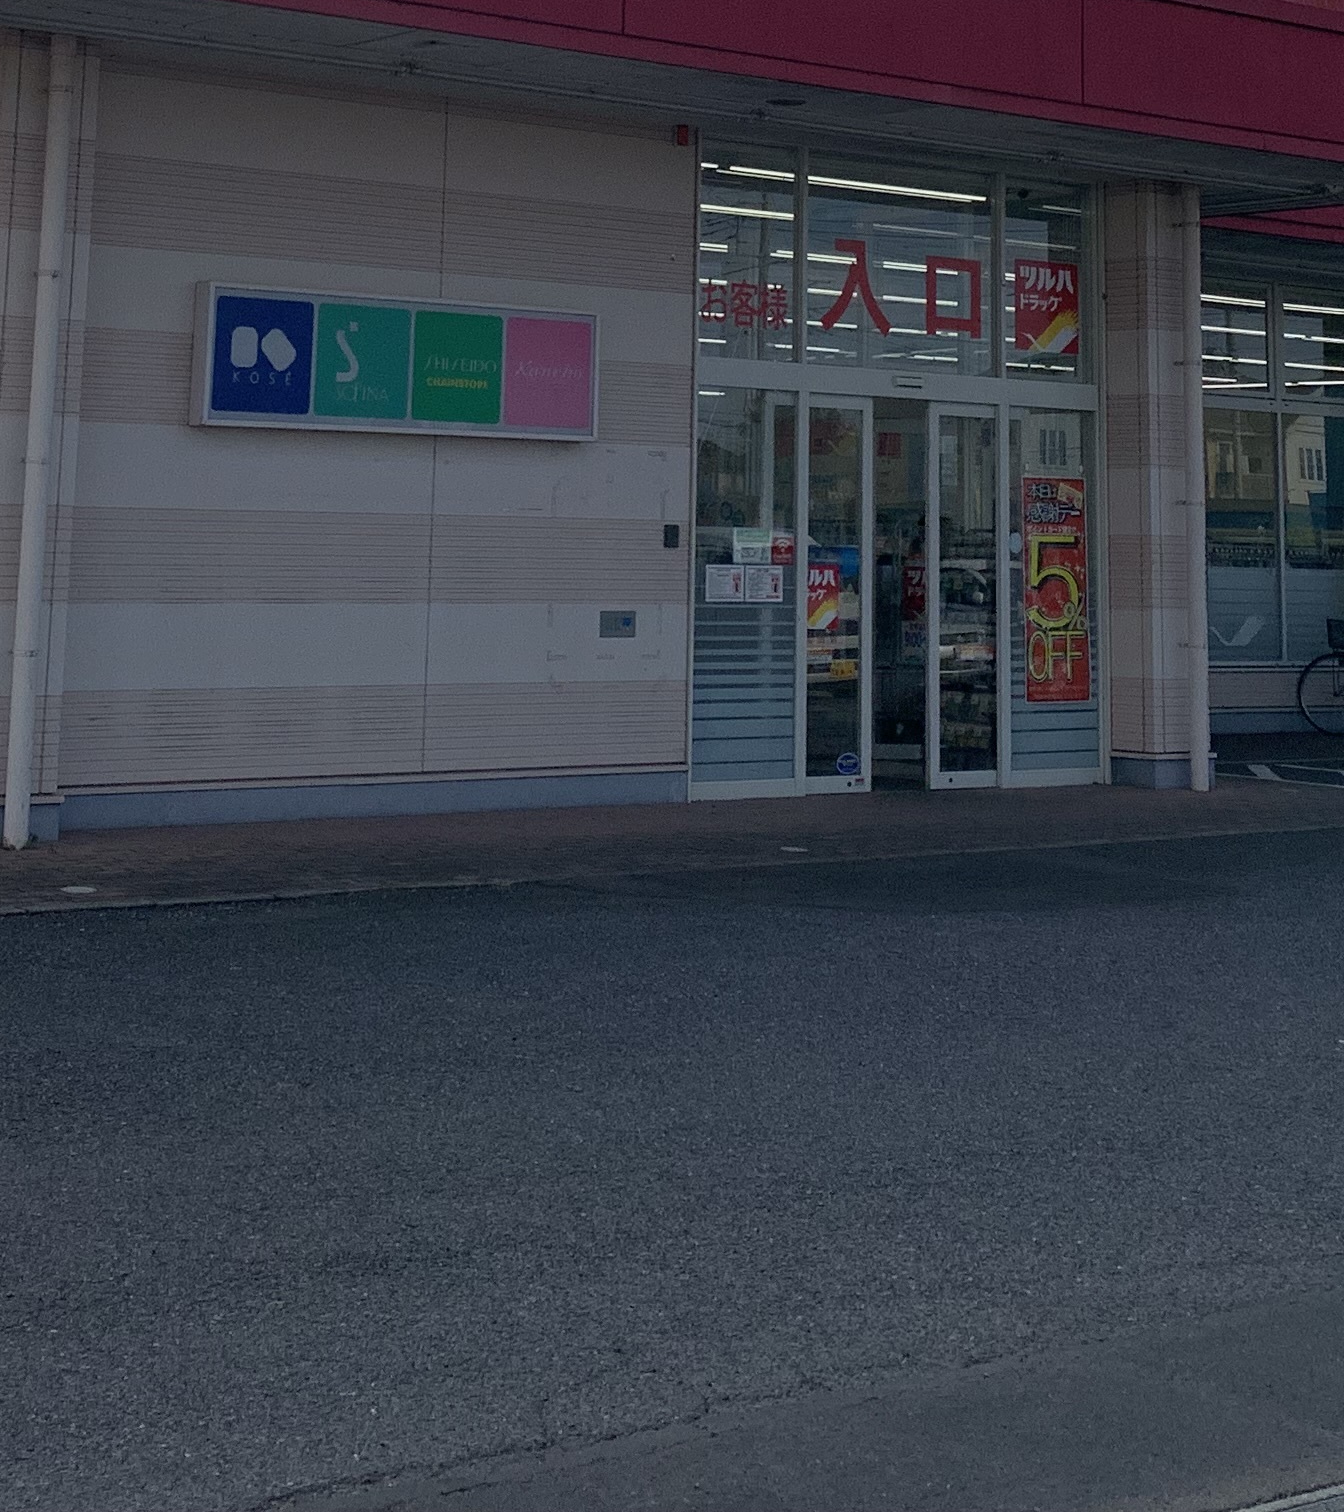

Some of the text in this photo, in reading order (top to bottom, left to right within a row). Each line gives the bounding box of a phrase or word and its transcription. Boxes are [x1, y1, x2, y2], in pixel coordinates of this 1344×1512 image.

[700, 238, 981, 339] お客様 入口
[1019, 265, 1074, 294] ツルハ
[1019, 295, 1063, 313] ドラッグ
[424, 355, 497, 374] SHISEIDO
[1028, 630, 1087, 684] OFF
